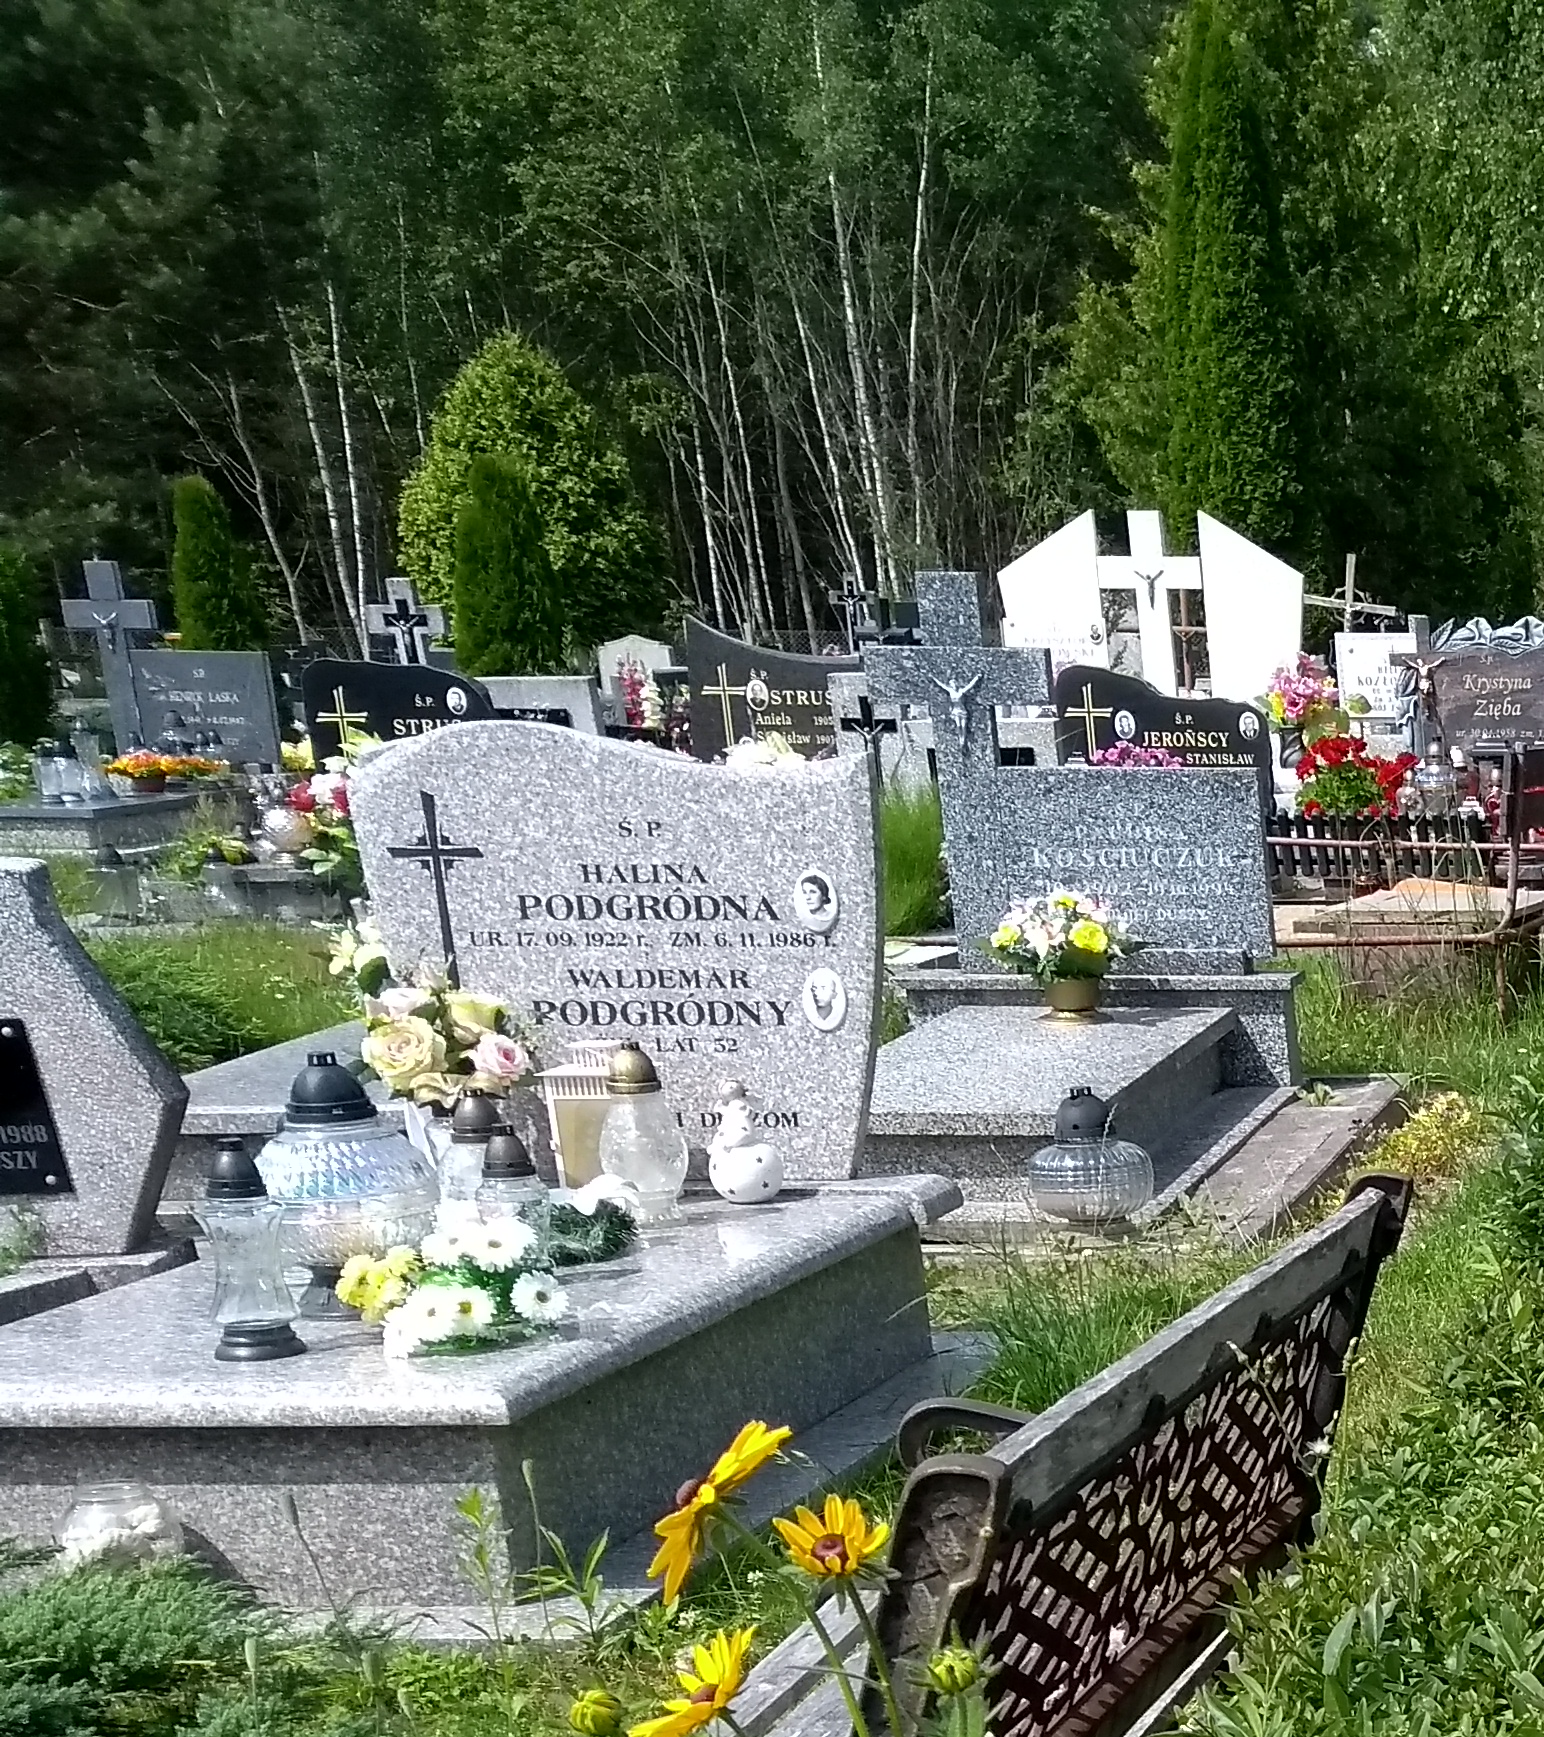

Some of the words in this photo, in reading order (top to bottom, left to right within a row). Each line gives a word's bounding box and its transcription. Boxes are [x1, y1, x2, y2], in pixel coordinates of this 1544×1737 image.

[1462, 674, 1533, 695] Krystyna
[755, 712, 792, 726] Aniela
[1473, 697, 1522, 721] Zięba
[1185, 753, 1255, 765] STANISŁAW
[579, 863, 709, 885] HALINA
[470, 931, 508, 948] UR.
[516, 932, 539, 948] 17.
[546, 932, 577, 948] 09.
[584, 931, 628, 948] 1922
[671, 932, 706, 948] ZM.
[714, 932, 732, 948] 6.
[769, 931, 815, 948] 1986
[567, 969, 751, 990] WALDEMAR
[531, 993, 792, 1027] PODGRÓDNY
[656, 1037, 699, 1053] LAT
[714, 1038, 738, 1053] 52
